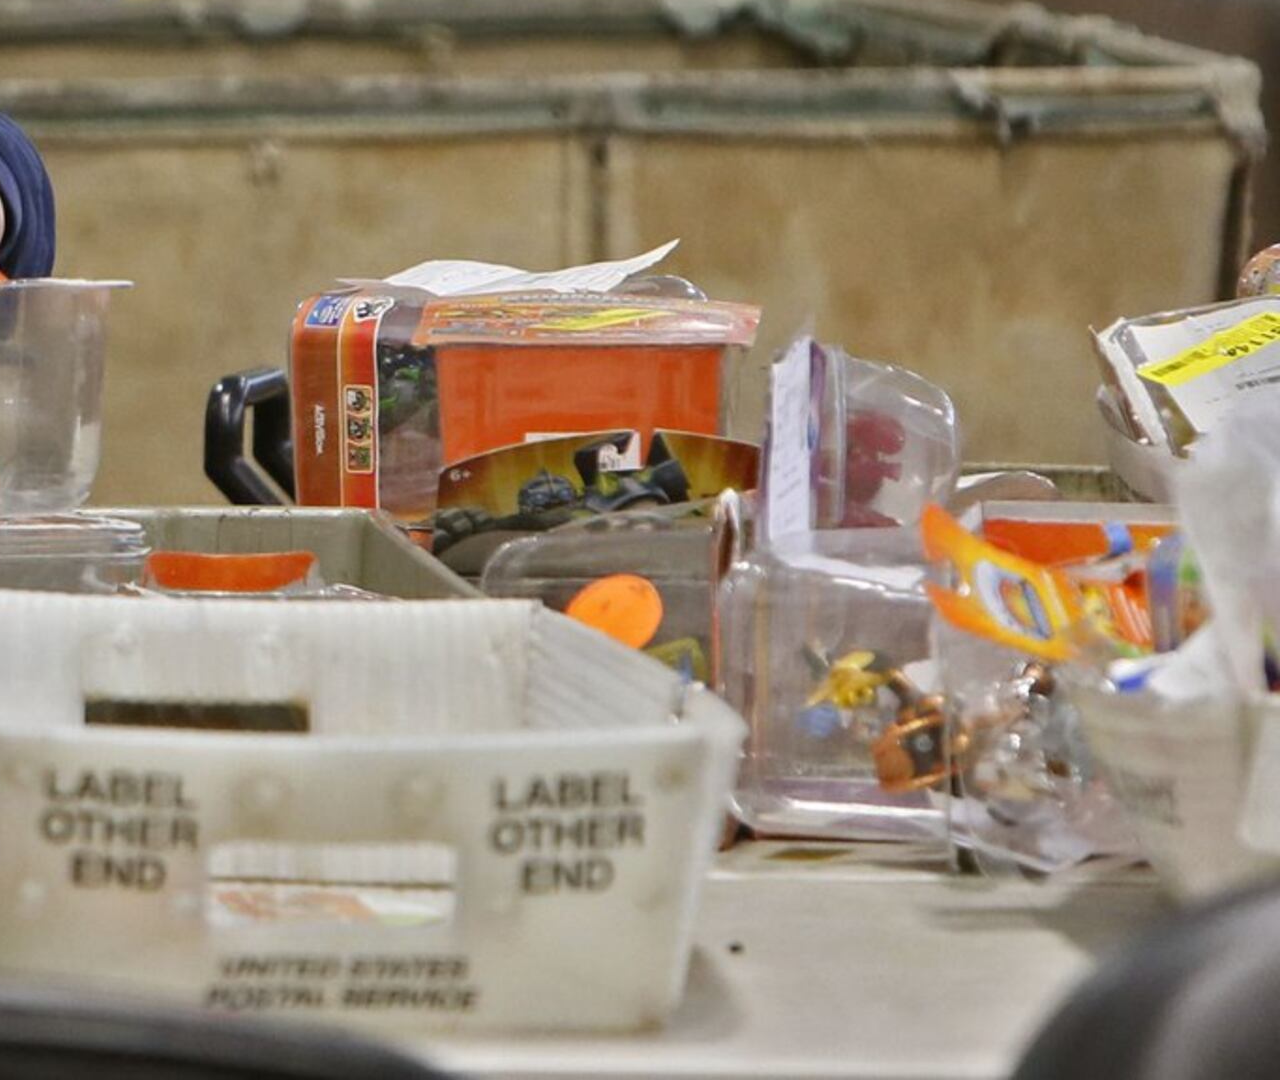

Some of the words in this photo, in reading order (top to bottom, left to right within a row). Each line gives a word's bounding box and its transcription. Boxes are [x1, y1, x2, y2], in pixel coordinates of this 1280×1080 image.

[44, 763, 199, 809] LABEL
[491, 772, 646, 813] LABEL
[40, 809, 200, 850] OTHER
[487, 814, 647, 855] OTHER
[69, 851, 168, 891] END
[520, 855, 615, 893] END
